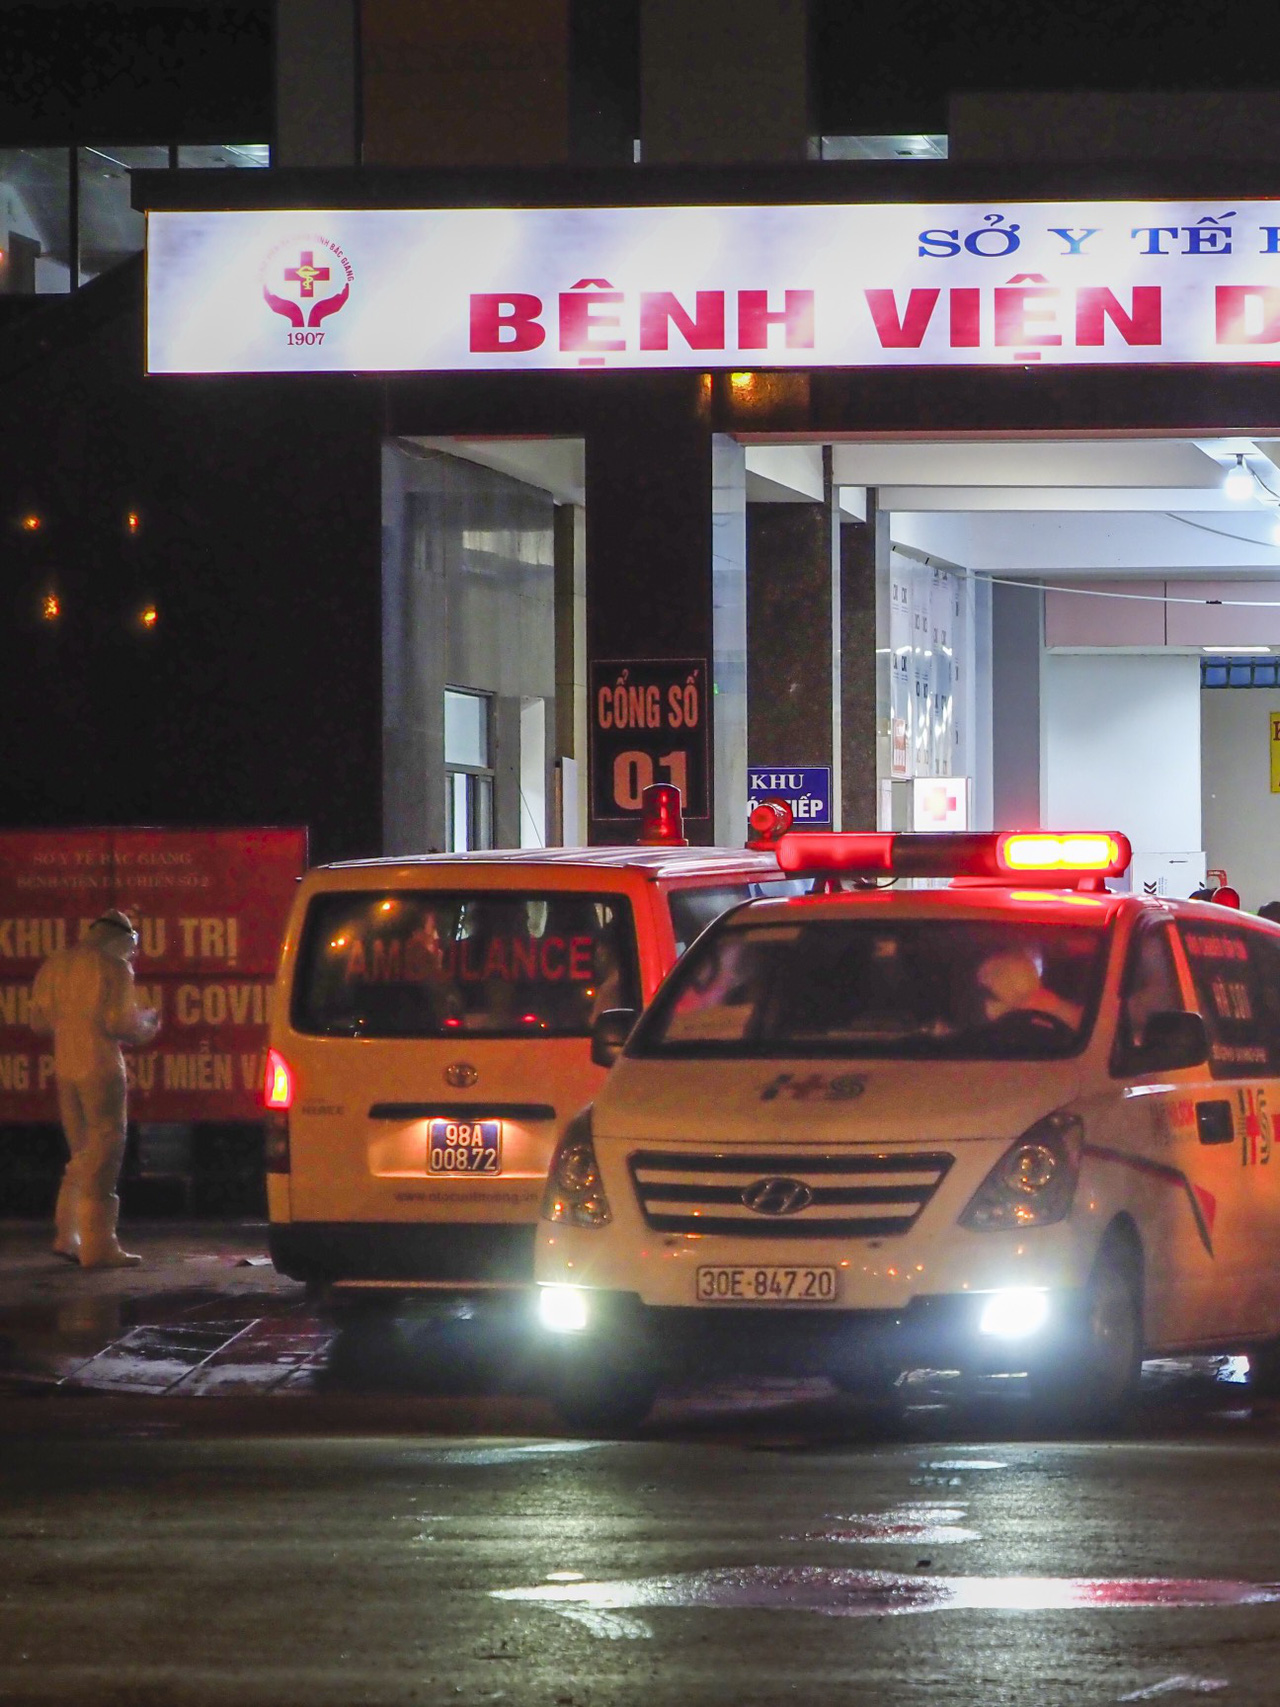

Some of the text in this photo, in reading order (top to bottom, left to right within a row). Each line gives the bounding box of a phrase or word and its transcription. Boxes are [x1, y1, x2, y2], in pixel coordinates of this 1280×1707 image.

[918, 213, 1021, 258] SỞ
[1047, 227, 1103, 256] Y
[1131, 211, 1237, 256] TẾ
[287, 332, 325, 346] 1907
[469, 278, 815, 367] BỆNH
[863, 273, 1162, 361] VIỆN
[598, 668, 699, 729] CỔNG SỐ
[613, 750, 687, 811] 01
[750, 774, 804, 789] KHU
[783, 792, 824, 818] IẾP
[178, 917, 238, 966] TRỊ
[345, 936, 593, 982] AMBULANCE
[445, 1124, 483, 1147] 98A
[431, 1148, 497, 1171] 008.72
